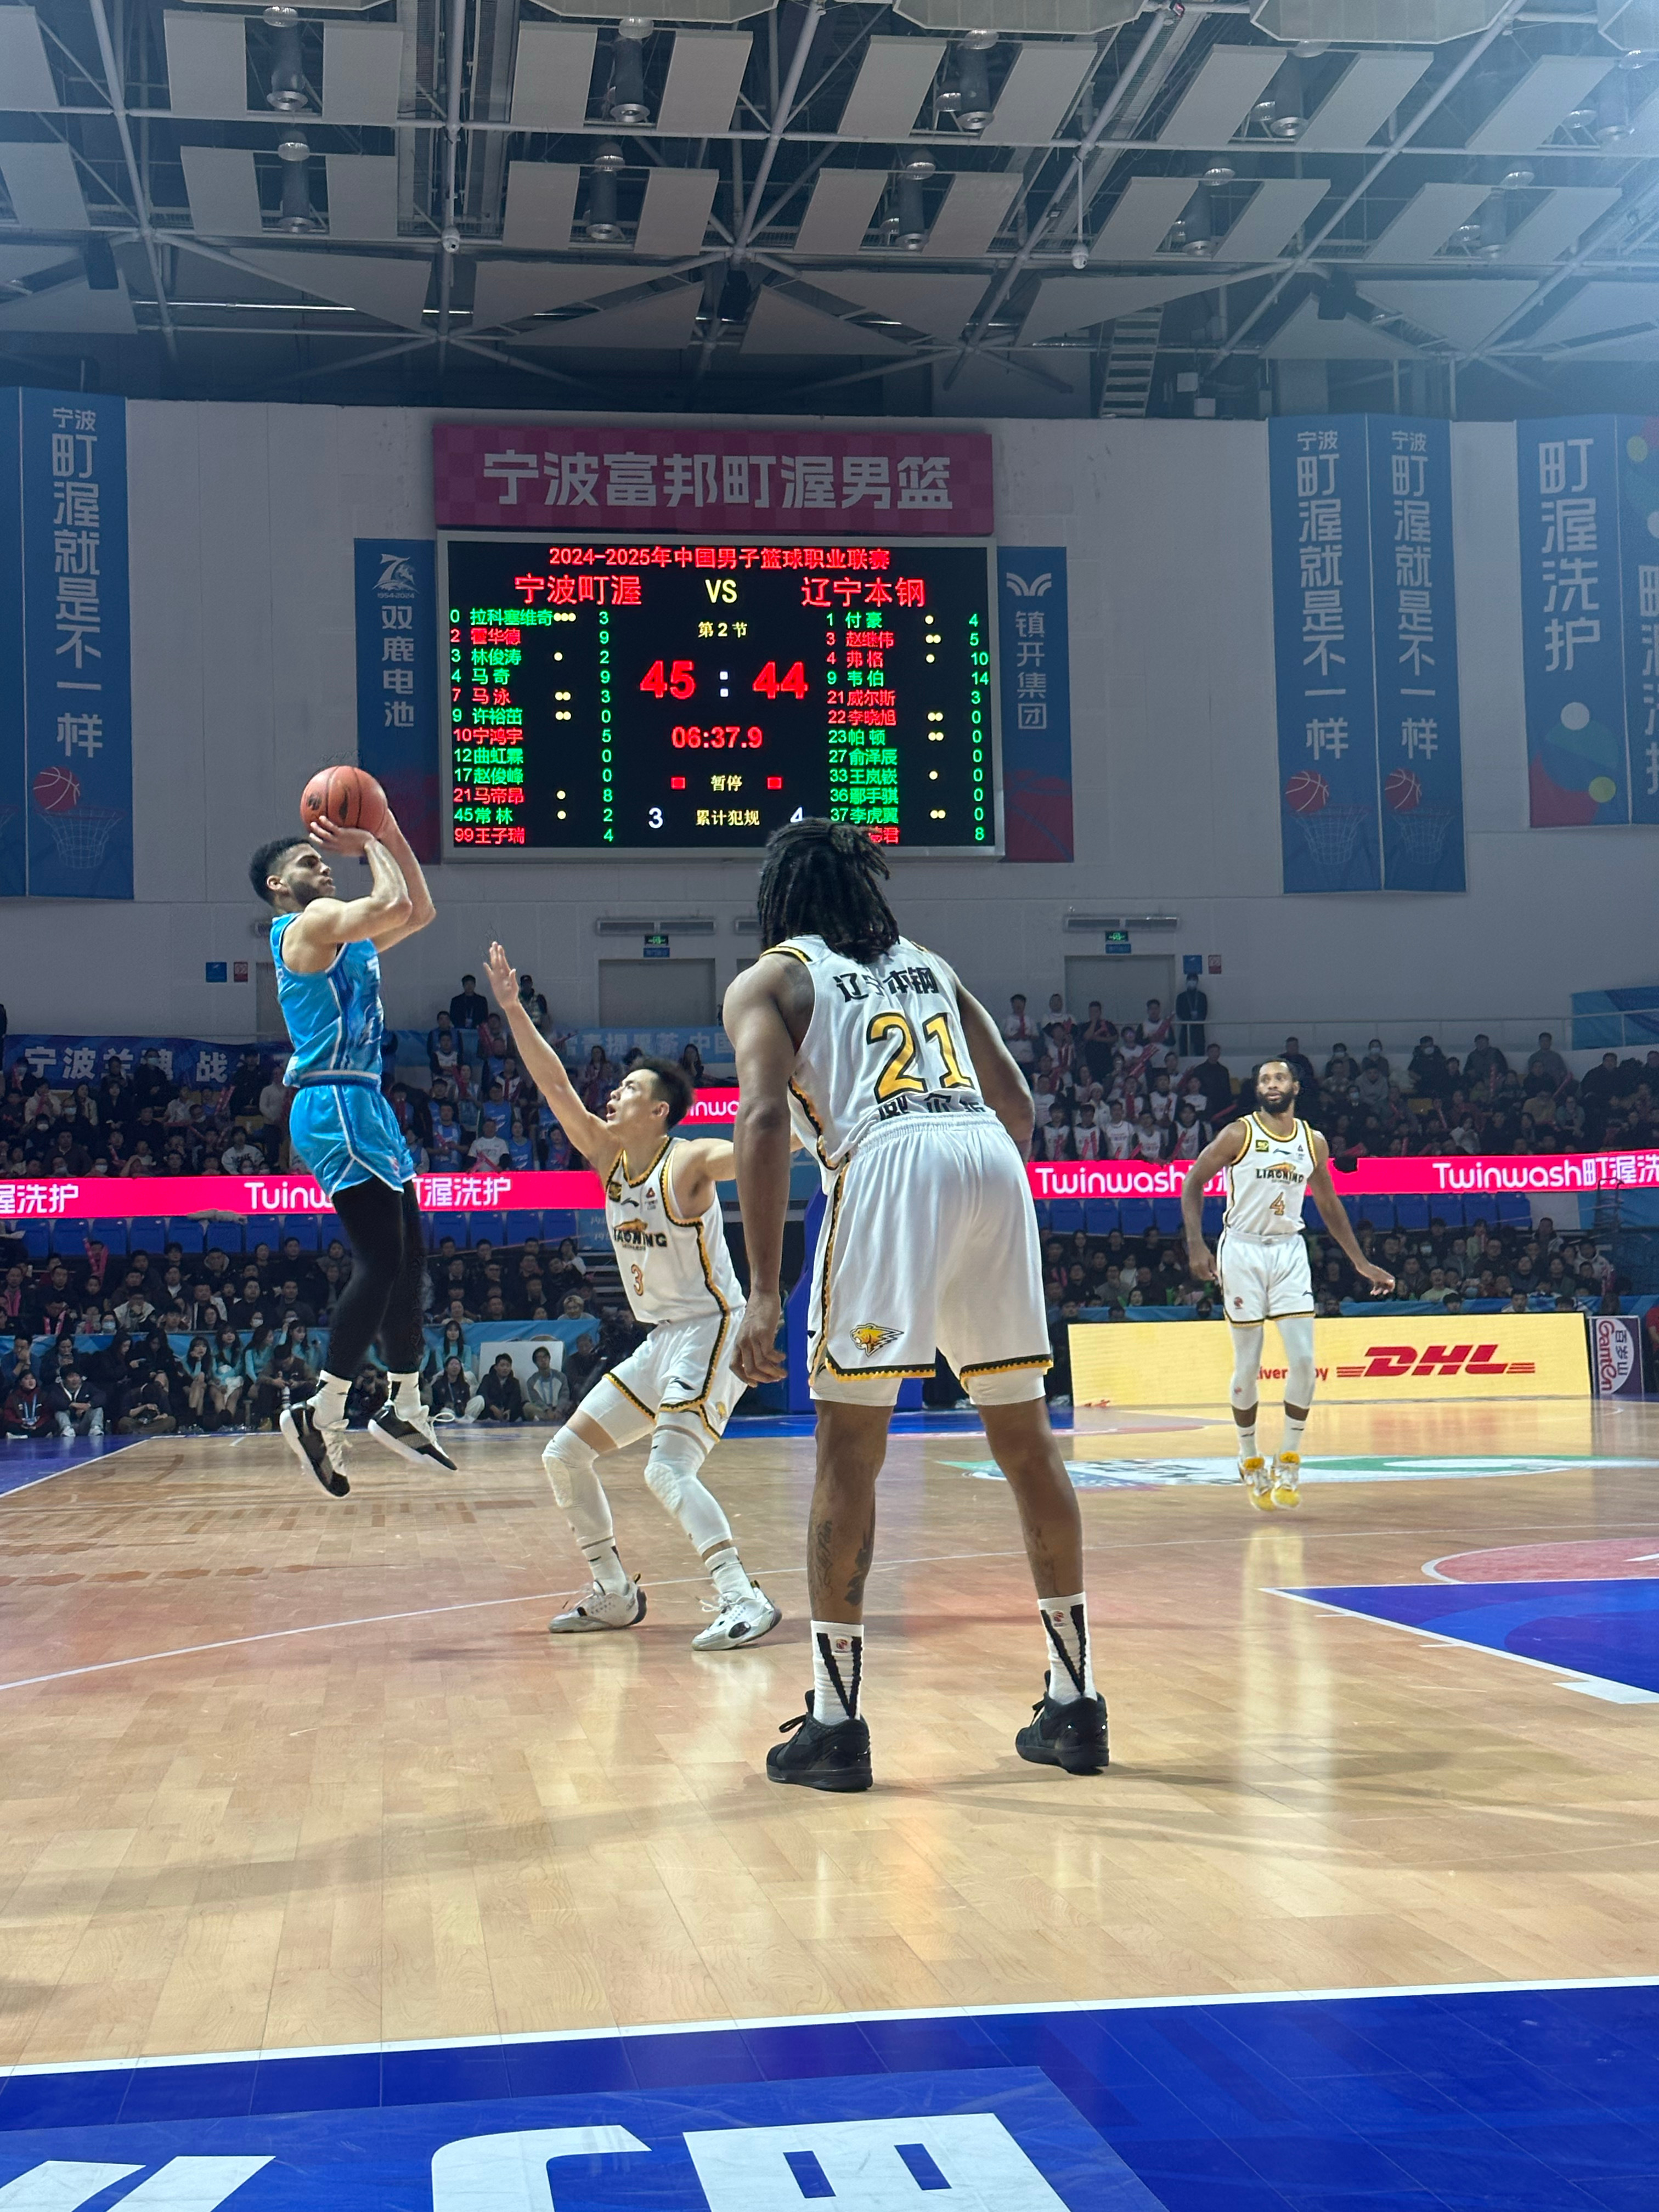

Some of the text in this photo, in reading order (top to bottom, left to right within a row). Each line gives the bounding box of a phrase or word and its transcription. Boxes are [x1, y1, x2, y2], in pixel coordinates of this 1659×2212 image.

[52, 407, 96, 431] 宁波
[1296, 430, 1338, 452] 宁波
[1391, 430, 1427, 452] 宁波
[483, 449, 953, 510] 宁波富邦町渥男篮
[550, 546, 890, 569] 2024-2025年中国男子篮球职业联赛
[1538, 438, 1601, 672] 町渥洗护
[52, 433, 103, 758] 町渥就是不一样
[515, 573, 925, 607] 宁波町渥 VS 辽宁本钢
[1296, 454, 1348, 760] 町渥就是不一样
[1392, 455, 1438, 760] 町渥就是不一样
[450, 608, 608, 625] 0 拉科塞维奇 3
[827, 613, 832, 626] 1
[969, 614, 978, 627] 4
[451, 628, 460, 642] 2
[600, 631, 609, 644] 9
[826, 630, 979, 648] 3 赵继伟 5
[452, 648, 609, 665] 3 林俊涛 2
[827, 652, 836, 664] 4
[971, 652, 989, 665] 10
[381, 605, 415, 728] 双鹿电池
[1015, 610, 1047, 730] 镇开集团
[452, 669, 461, 682] 4
[601, 670, 610, 684] 9
[640, 661, 696, 699] 45
[753, 662, 808, 699] 44
[827, 671, 837, 684] 9
[972, 672, 989, 685] 14
[453, 688, 461, 701] 7
[601, 690, 610, 703] 3
[827, 689, 980, 707] 21 威尔斯 3
[453, 708, 461, 722] 9
[602, 709, 611, 723] 0
[828, 709, 981, 726] 22 李晓旭 0
[453, 727, 611, 745] 10 宁鸿宇 5
[672, 726, 762, 748] 06:37.9
[829, 730, 847, 743] 23
[973, 730, 982, 743] 0
[454, 748, 472, 761] 12
[602, 749, 611, 762] 0
[829, 748, 982, 765] 27 俞泽辰 0
[455, 768, 612, 785] 17 赵俊峰 0
[711, 775, 742, 791] 暂停
[830, 769, 848, 782] 33
[973, 768, 983, 782] 0
[454, 788, 471, 802] 21
[603, 788, 612, 802] 8
[831, 788, 848, 802] 36
[974, 788, 983, 801] 0
[454, 808, 473, 821] 45
[603, 808, 612, 821] 2
[649, 806, 803, 828] 3 累计犯规 4
[831, 807, 984, 824] 37 李虎翼 0
[455, 827, 613, 844] 99 王子瑞 4
[975, 827, 984, 840] 8
[866, 1012, 975, 1104] 21
[1269, 1192, 1285, 1216] 4
[613, 1228, 668, 1248] IAONING
[630, 1263, 644, 1296] 3
[1364, 1344, 1508, 1377] DHL
[1615, 1330, 1628, 1375] 百岁山
